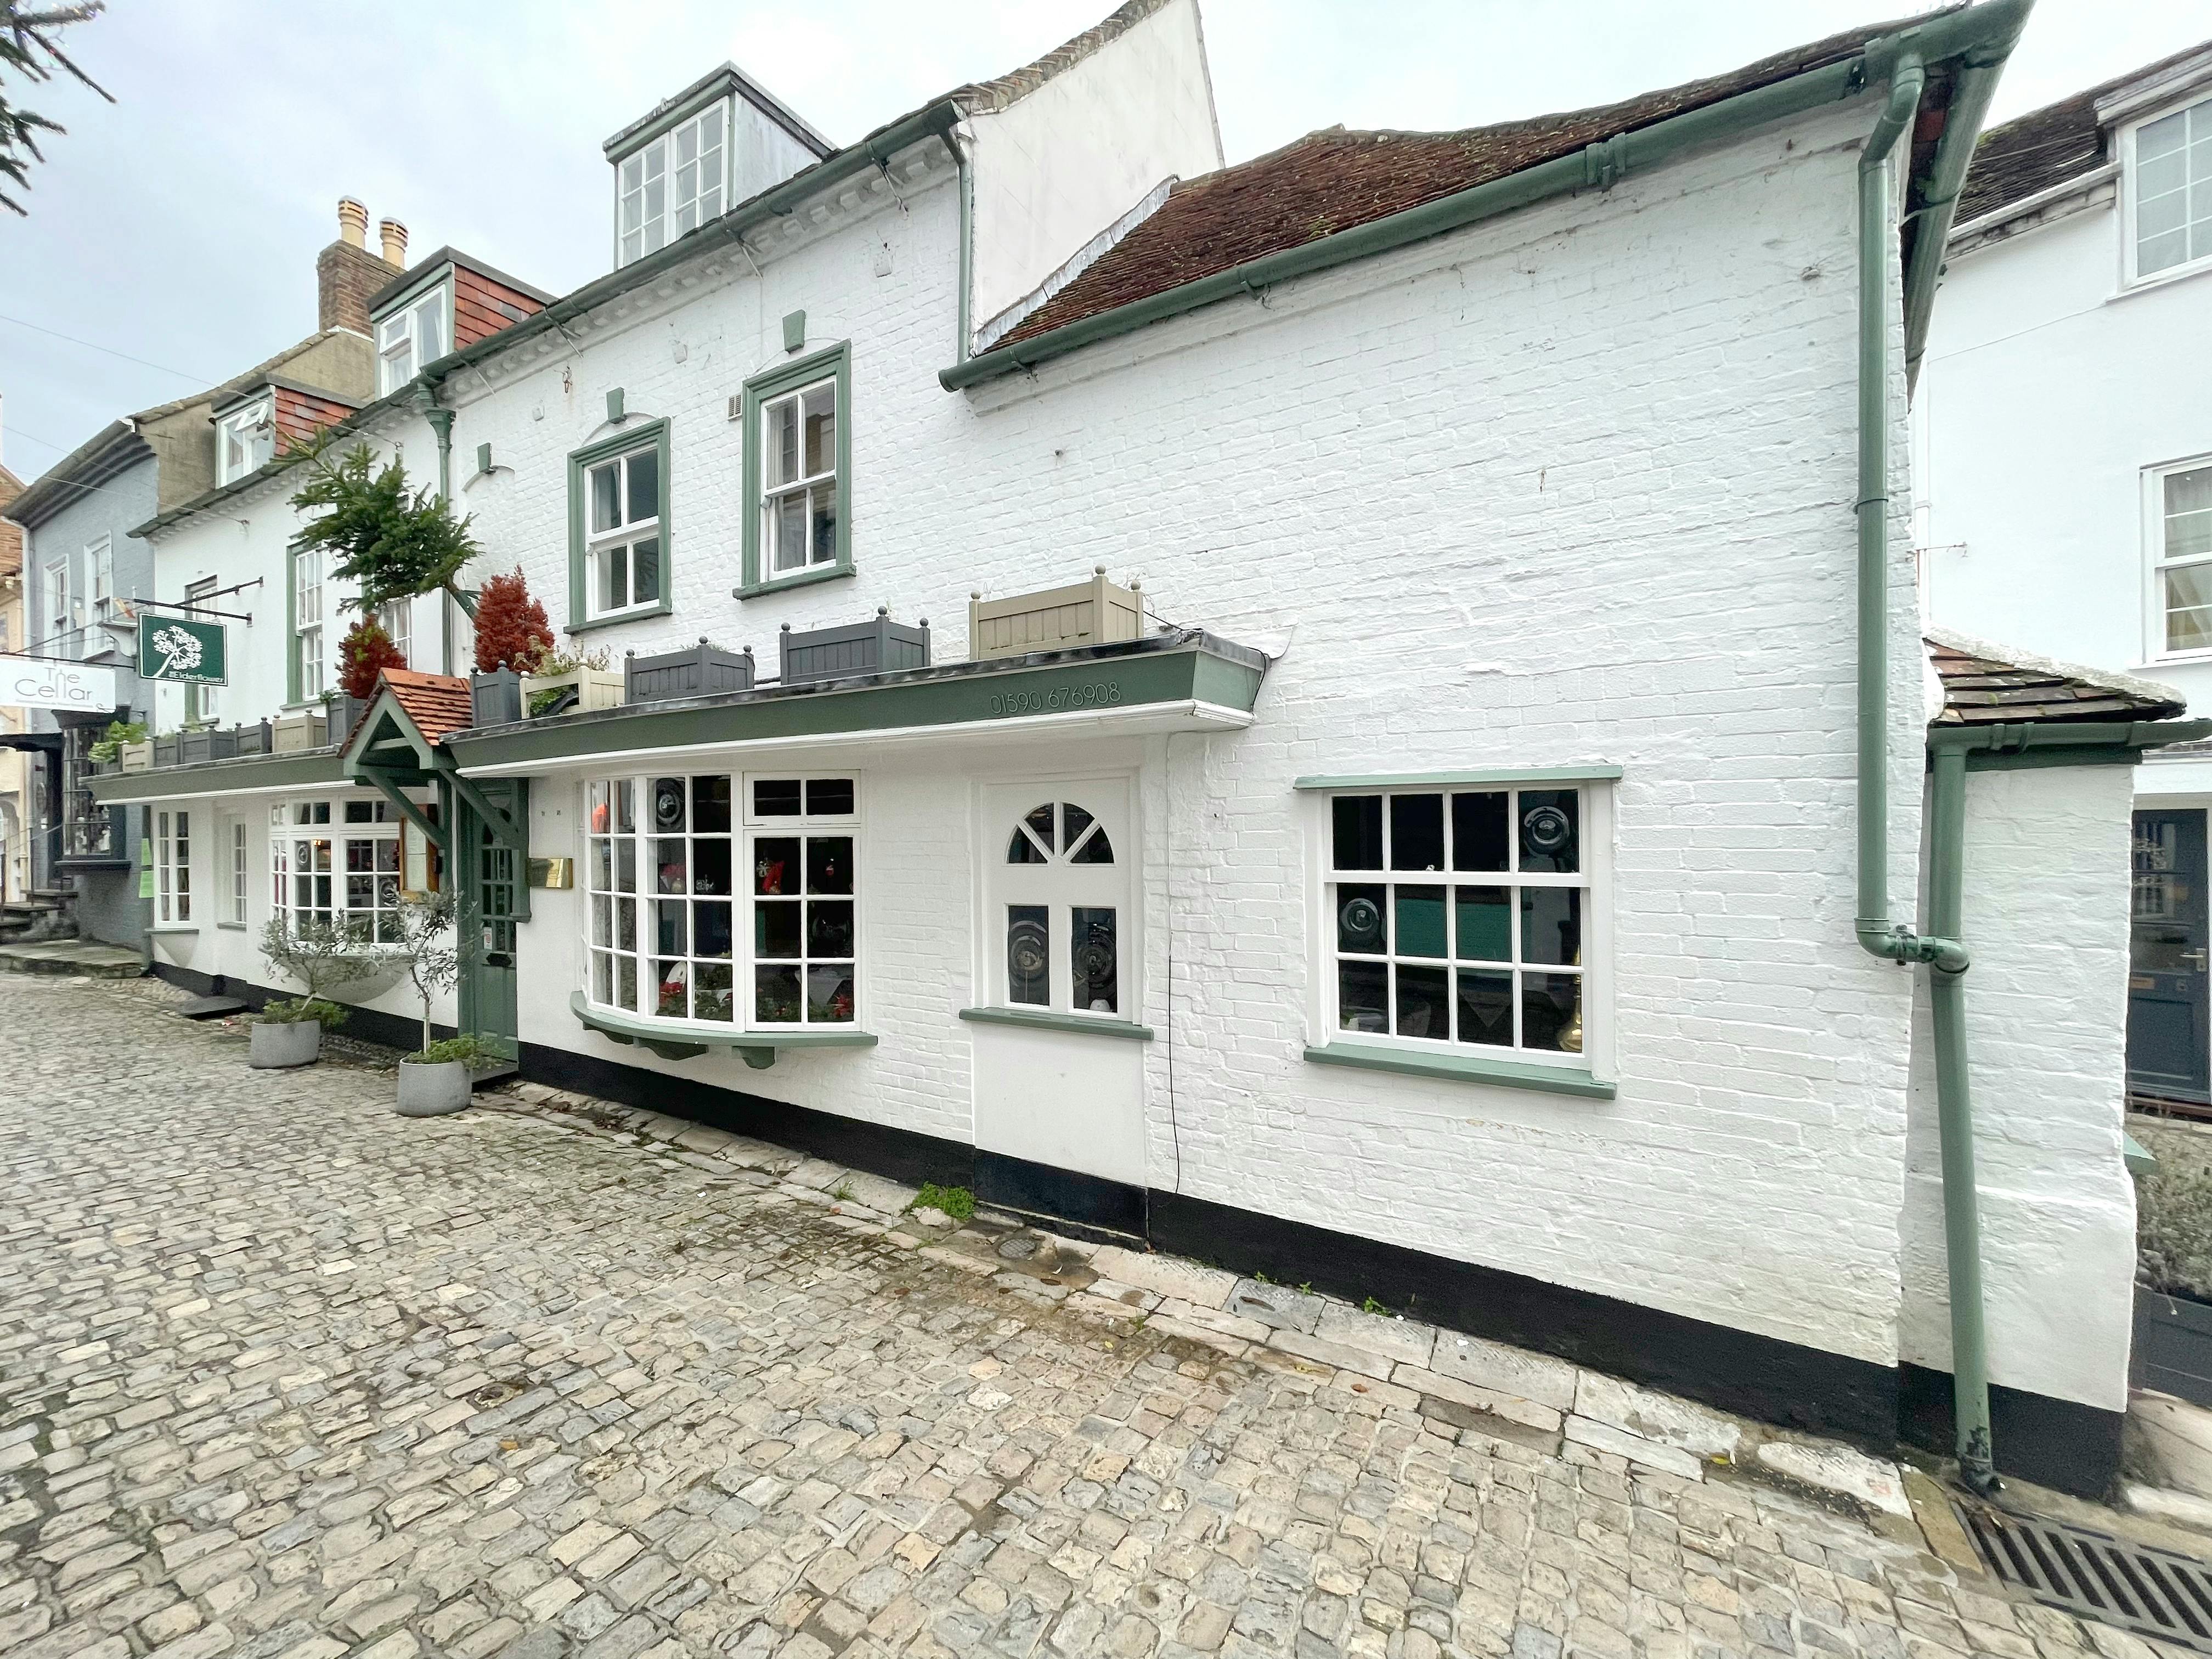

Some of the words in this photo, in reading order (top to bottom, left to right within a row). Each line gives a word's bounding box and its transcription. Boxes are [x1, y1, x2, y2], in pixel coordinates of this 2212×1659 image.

[44, 667, 80, 684] The
[15, 679, 93, 701] Cellar
[990, 691, 1042, 714] 01590
[1048, 681, 1121, 708] 676908
